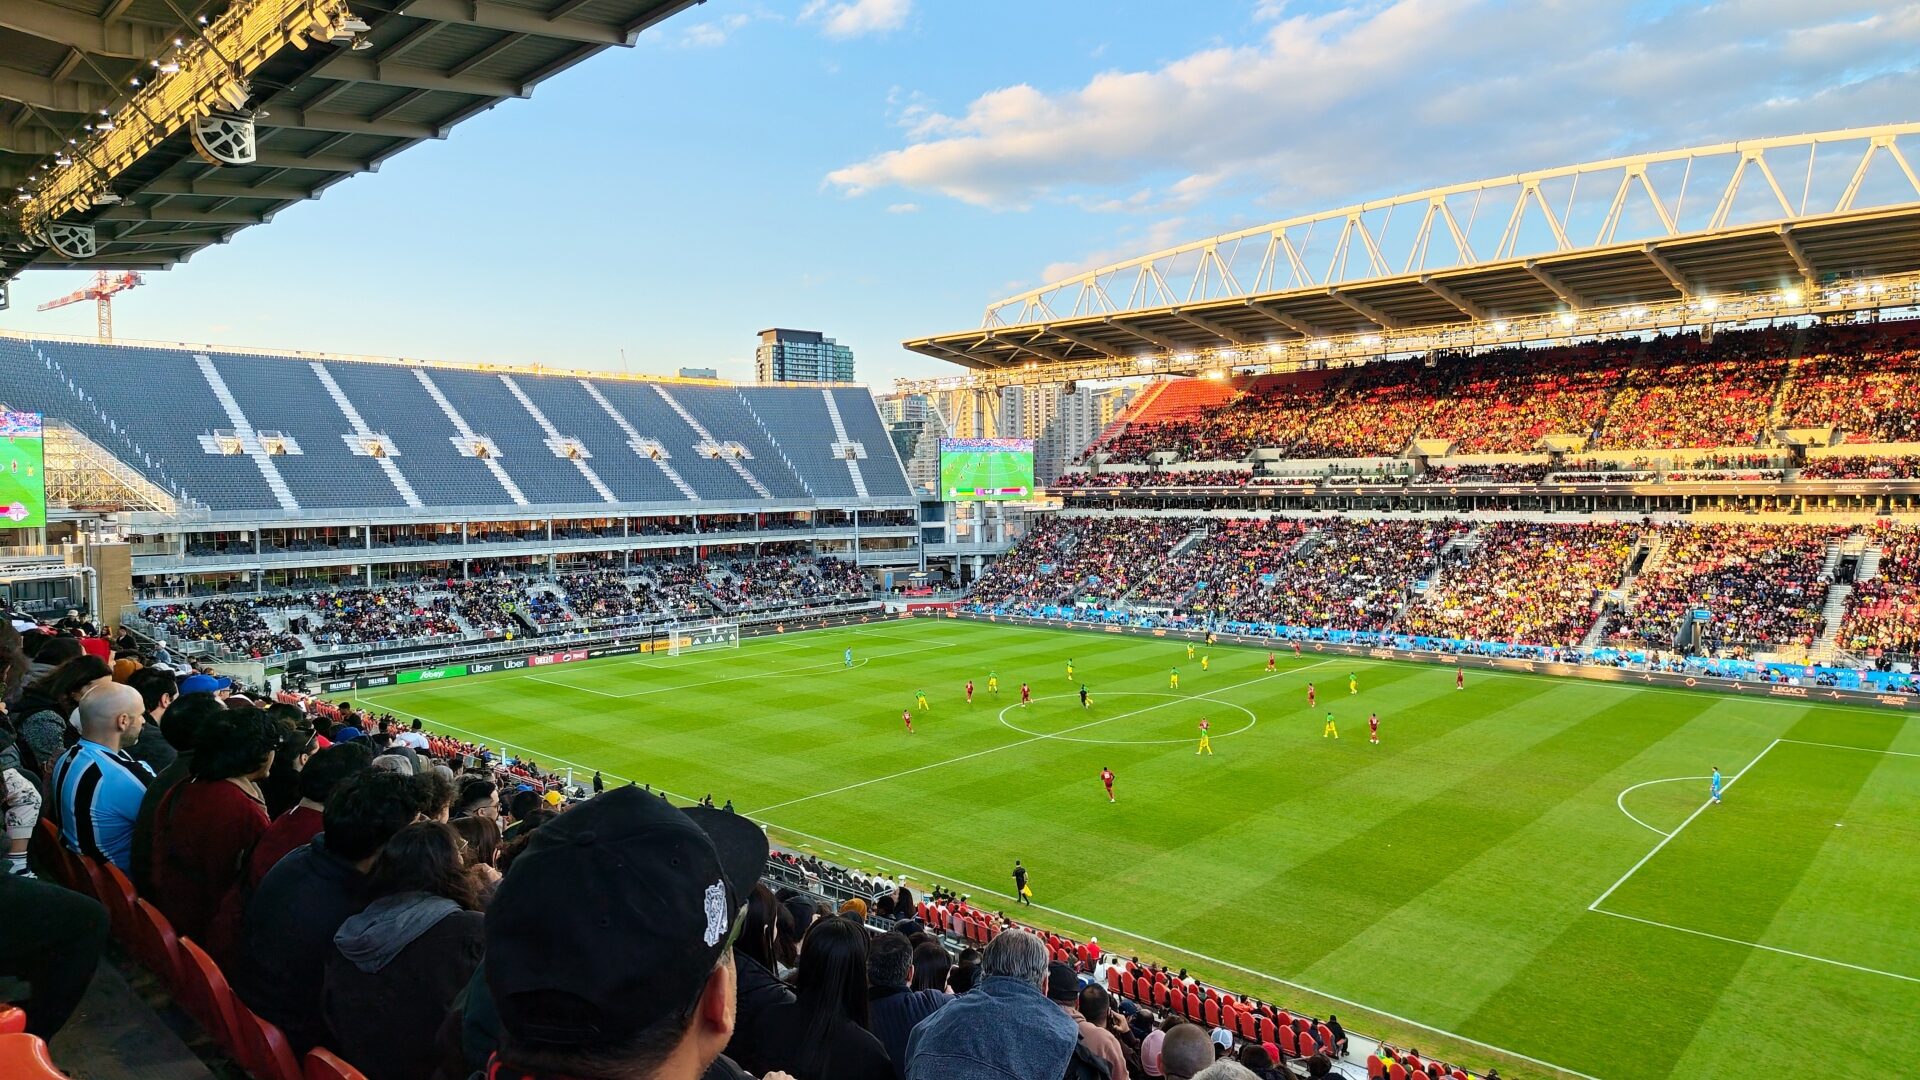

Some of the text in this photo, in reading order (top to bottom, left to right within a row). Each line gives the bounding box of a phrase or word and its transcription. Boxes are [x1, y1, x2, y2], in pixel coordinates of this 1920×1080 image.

[645, 640, 675, 650] Cotinental
[605, 646, 639, 654] CHEVROLET
[471, 664, 493, 673] Uber
[503, 660, 524, 669] Uber
[1772, 685, 1806, 695] LEGACY
